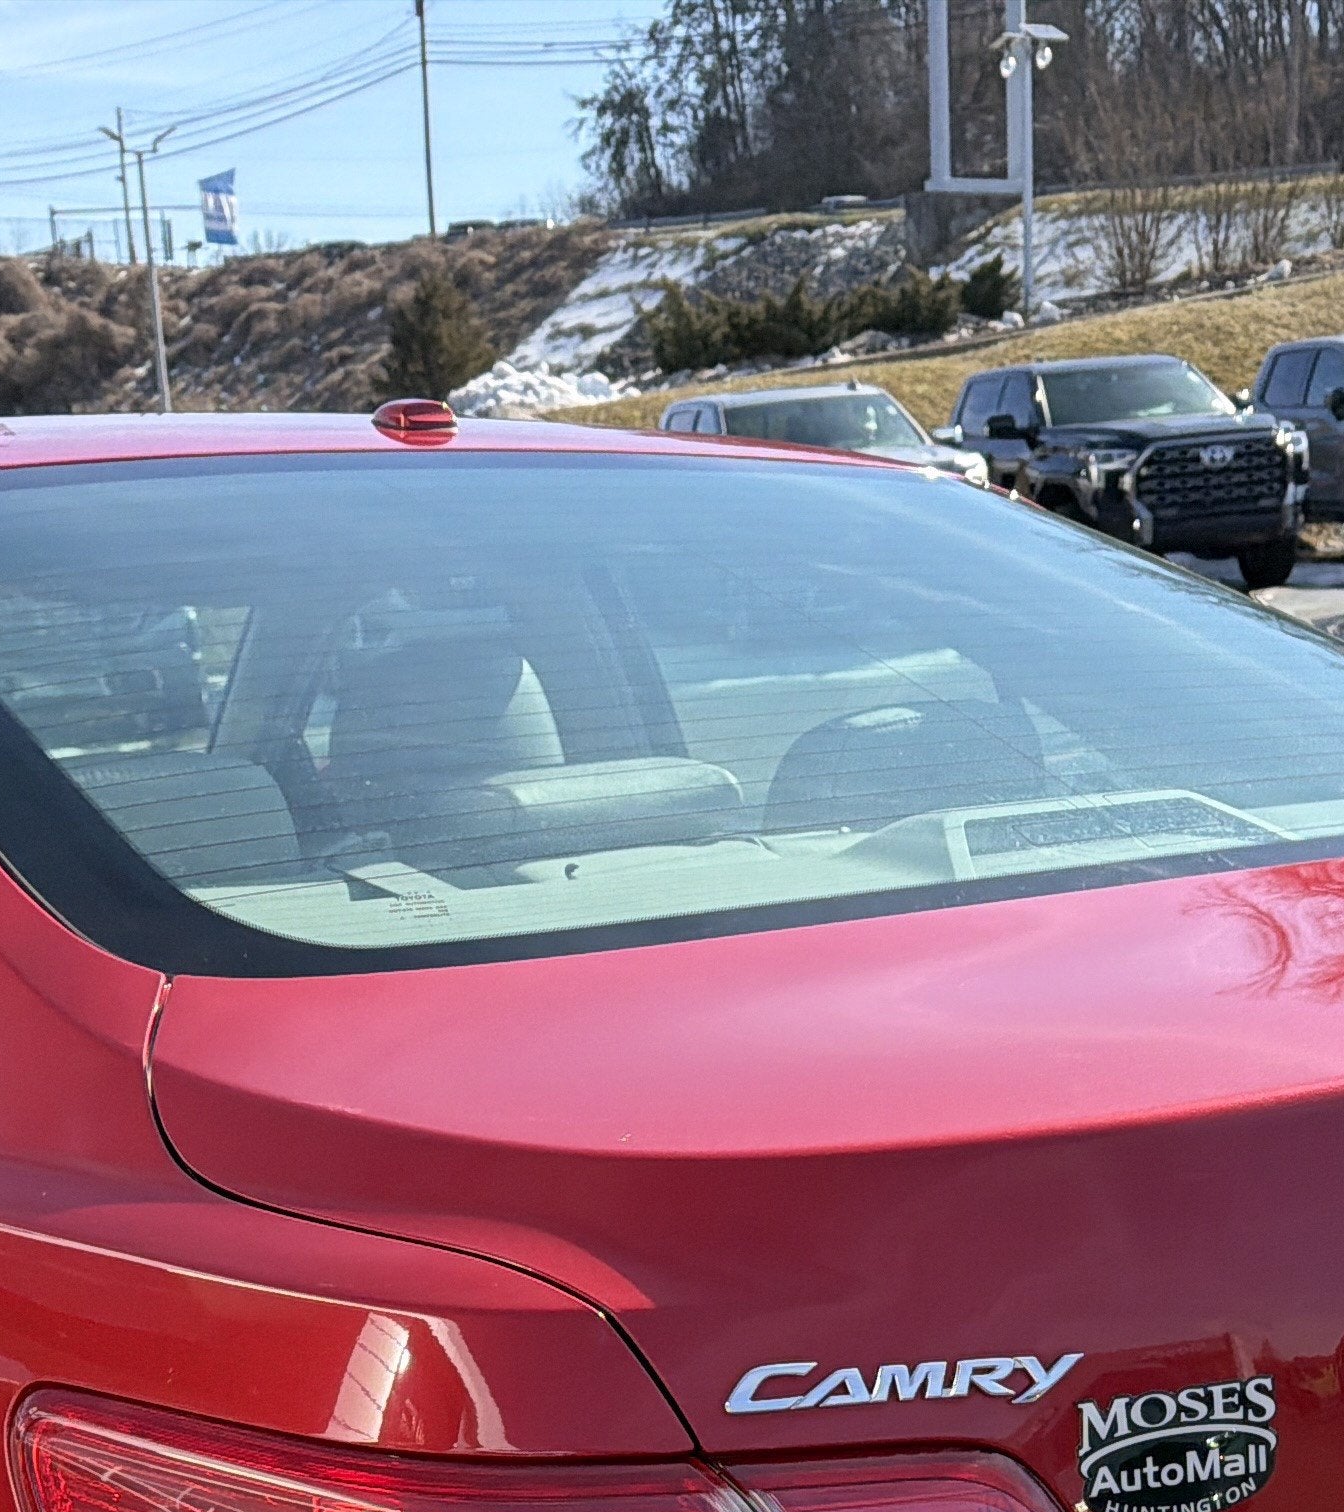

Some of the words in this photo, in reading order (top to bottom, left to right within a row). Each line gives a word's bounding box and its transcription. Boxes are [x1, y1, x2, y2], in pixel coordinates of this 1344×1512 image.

[724, 1352, 1085, 1413] CAMRY
[1077, 1376, 1277, 1457] MOSES
[1089, 1444, 1268, 1498] AutoMall
